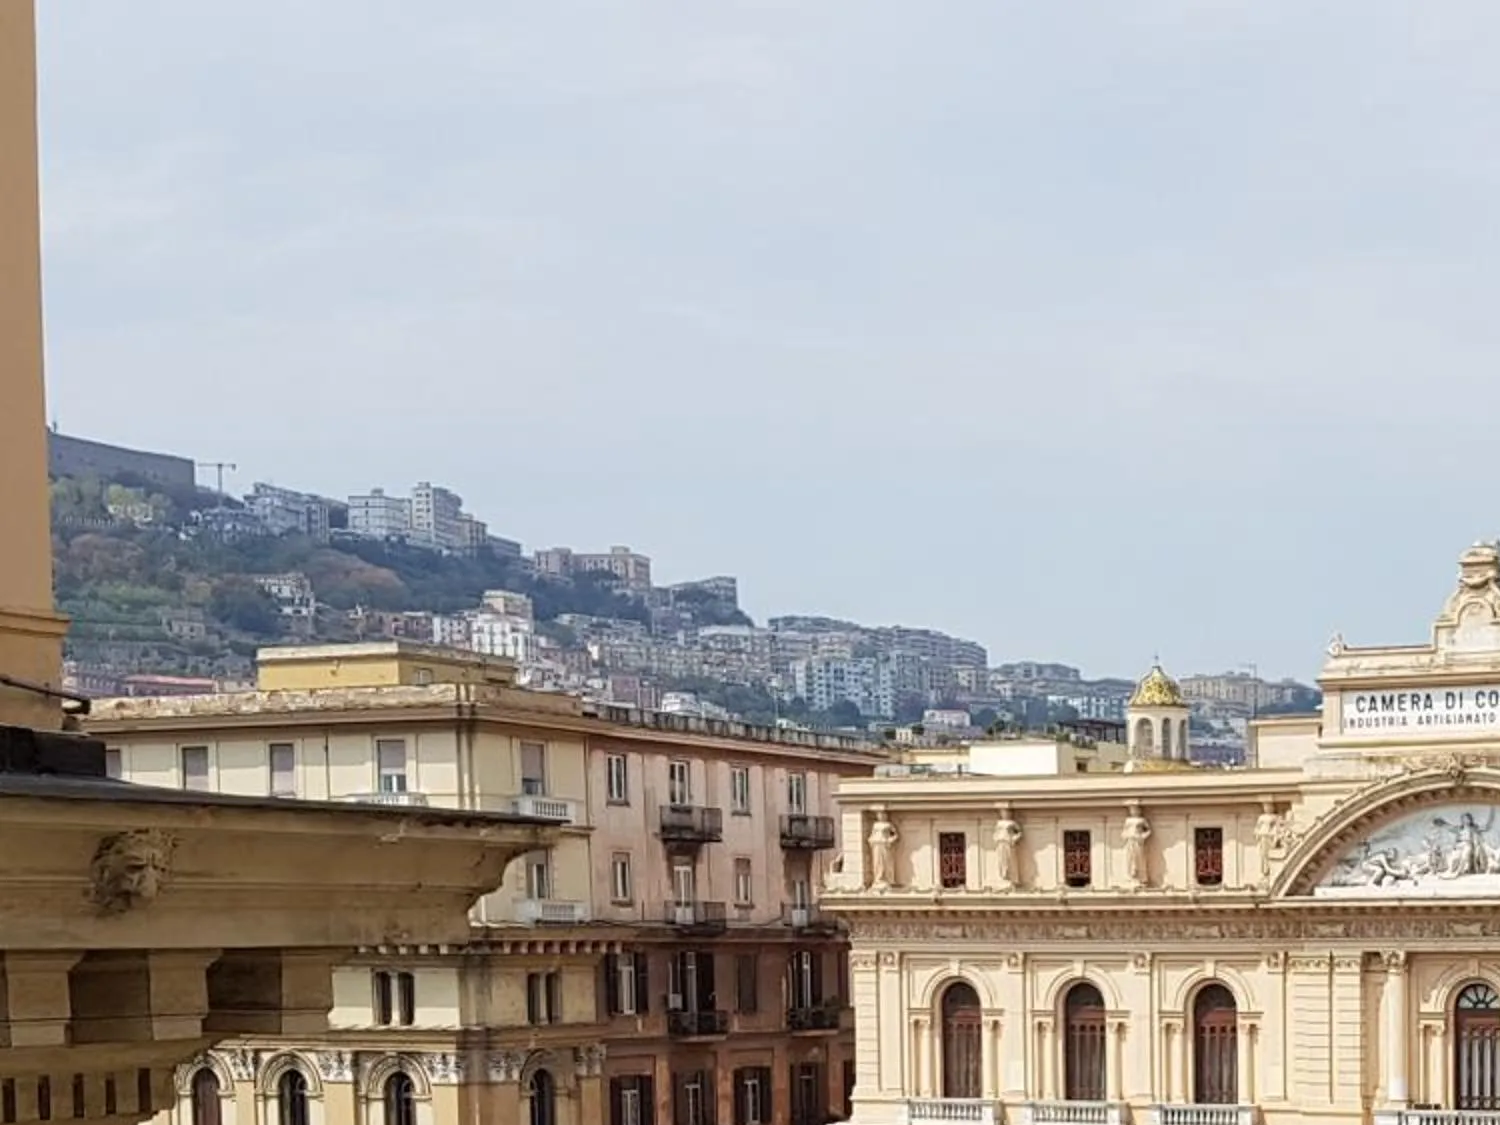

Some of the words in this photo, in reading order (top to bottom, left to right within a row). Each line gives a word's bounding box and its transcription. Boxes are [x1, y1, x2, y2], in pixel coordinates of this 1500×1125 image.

[1355, 693, 1433, 713] CAMERA
[1445, 691, 1463, 709] DI
[1344, 715, 1408, 729] INDUSTRIA
[1417, 711, 1496, 726] ARTIGIANATO
